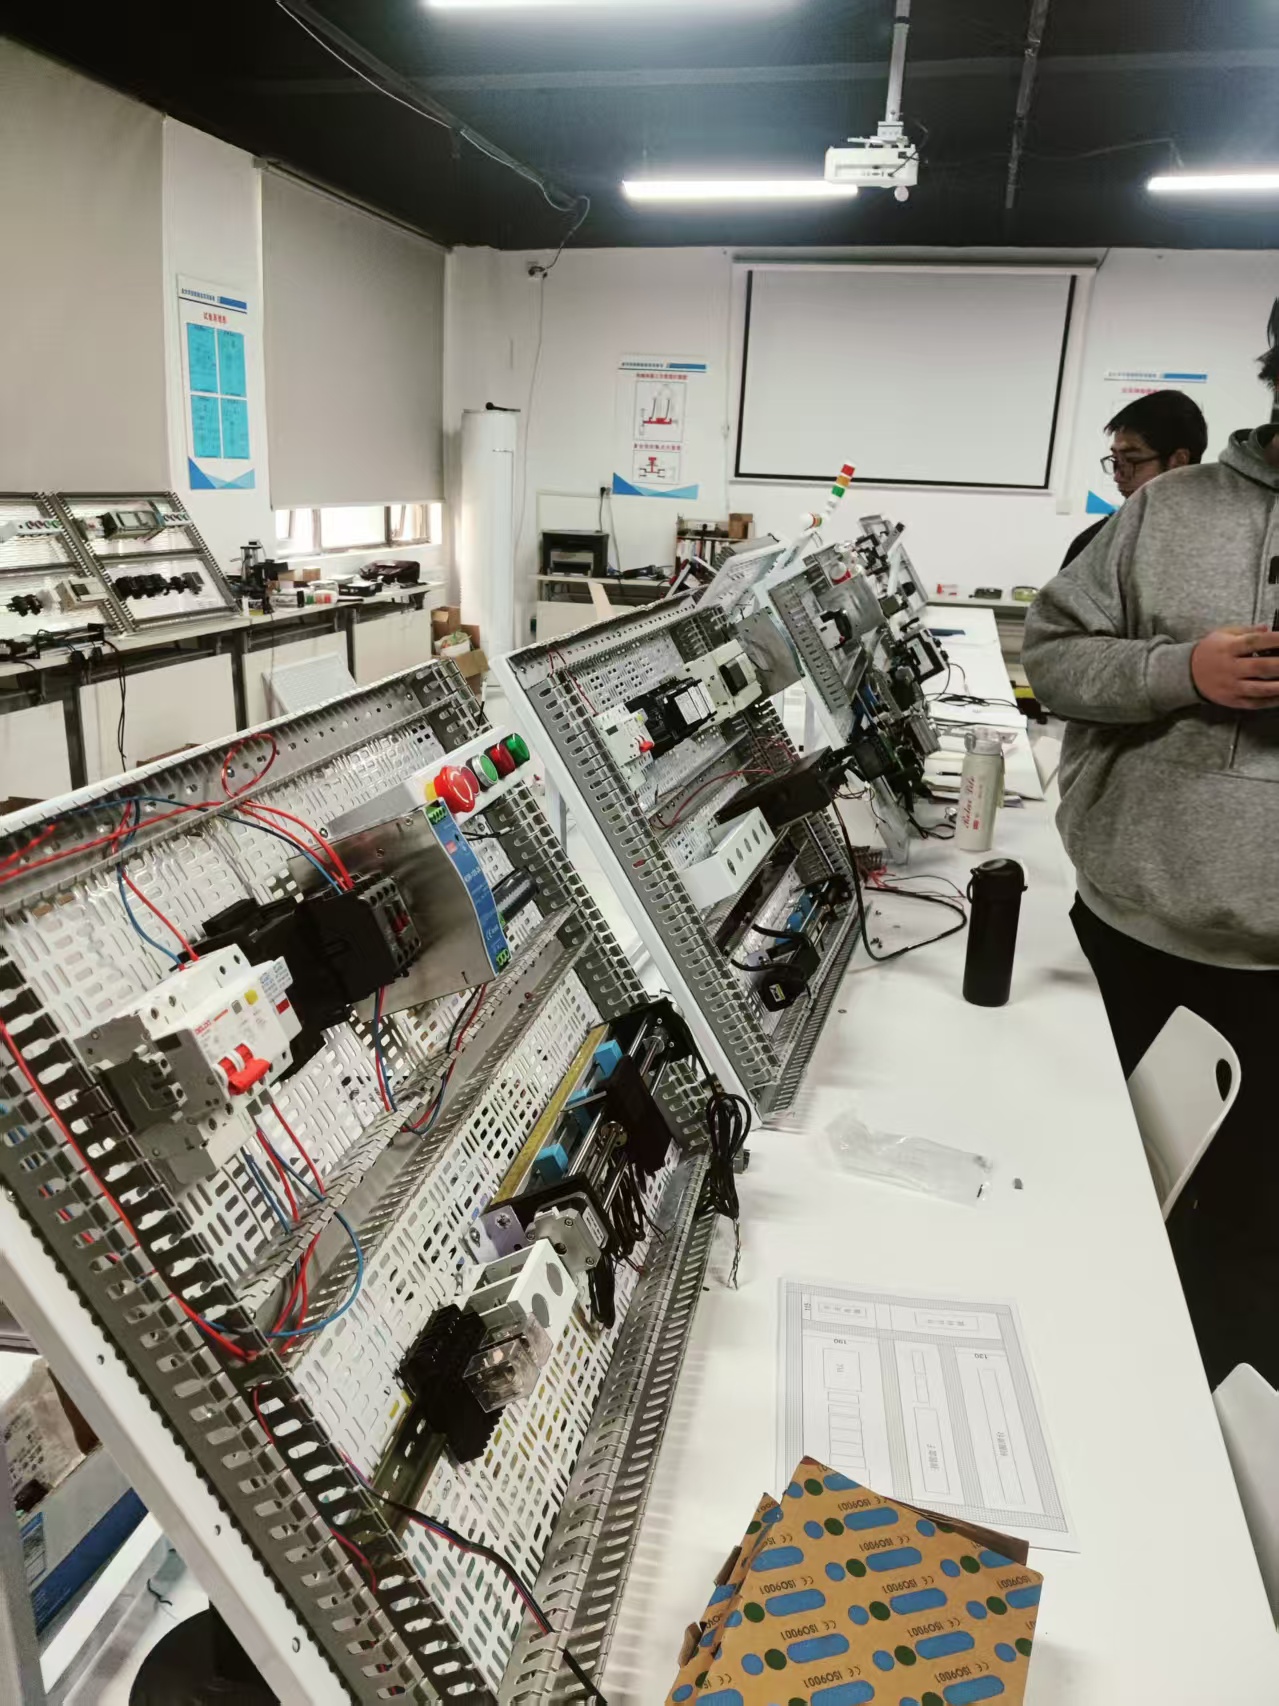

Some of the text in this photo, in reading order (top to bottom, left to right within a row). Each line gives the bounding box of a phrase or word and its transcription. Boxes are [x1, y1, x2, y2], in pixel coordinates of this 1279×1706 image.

[838, 1499, 872, 1512] ISO9001
[859, 1538, 895, 1552] ISO9001
[759, 1579, 797, 1595] ISO9001
[882, 1579, 919, 1594] ISO9001
[780, 1626, 819, 1641] ISO9001
[907, 1623, 944, 1638] ISO9001
[803, 1671, 843, 1688] ISO9001
[934, 1667, 972, 1683] ISO9001
